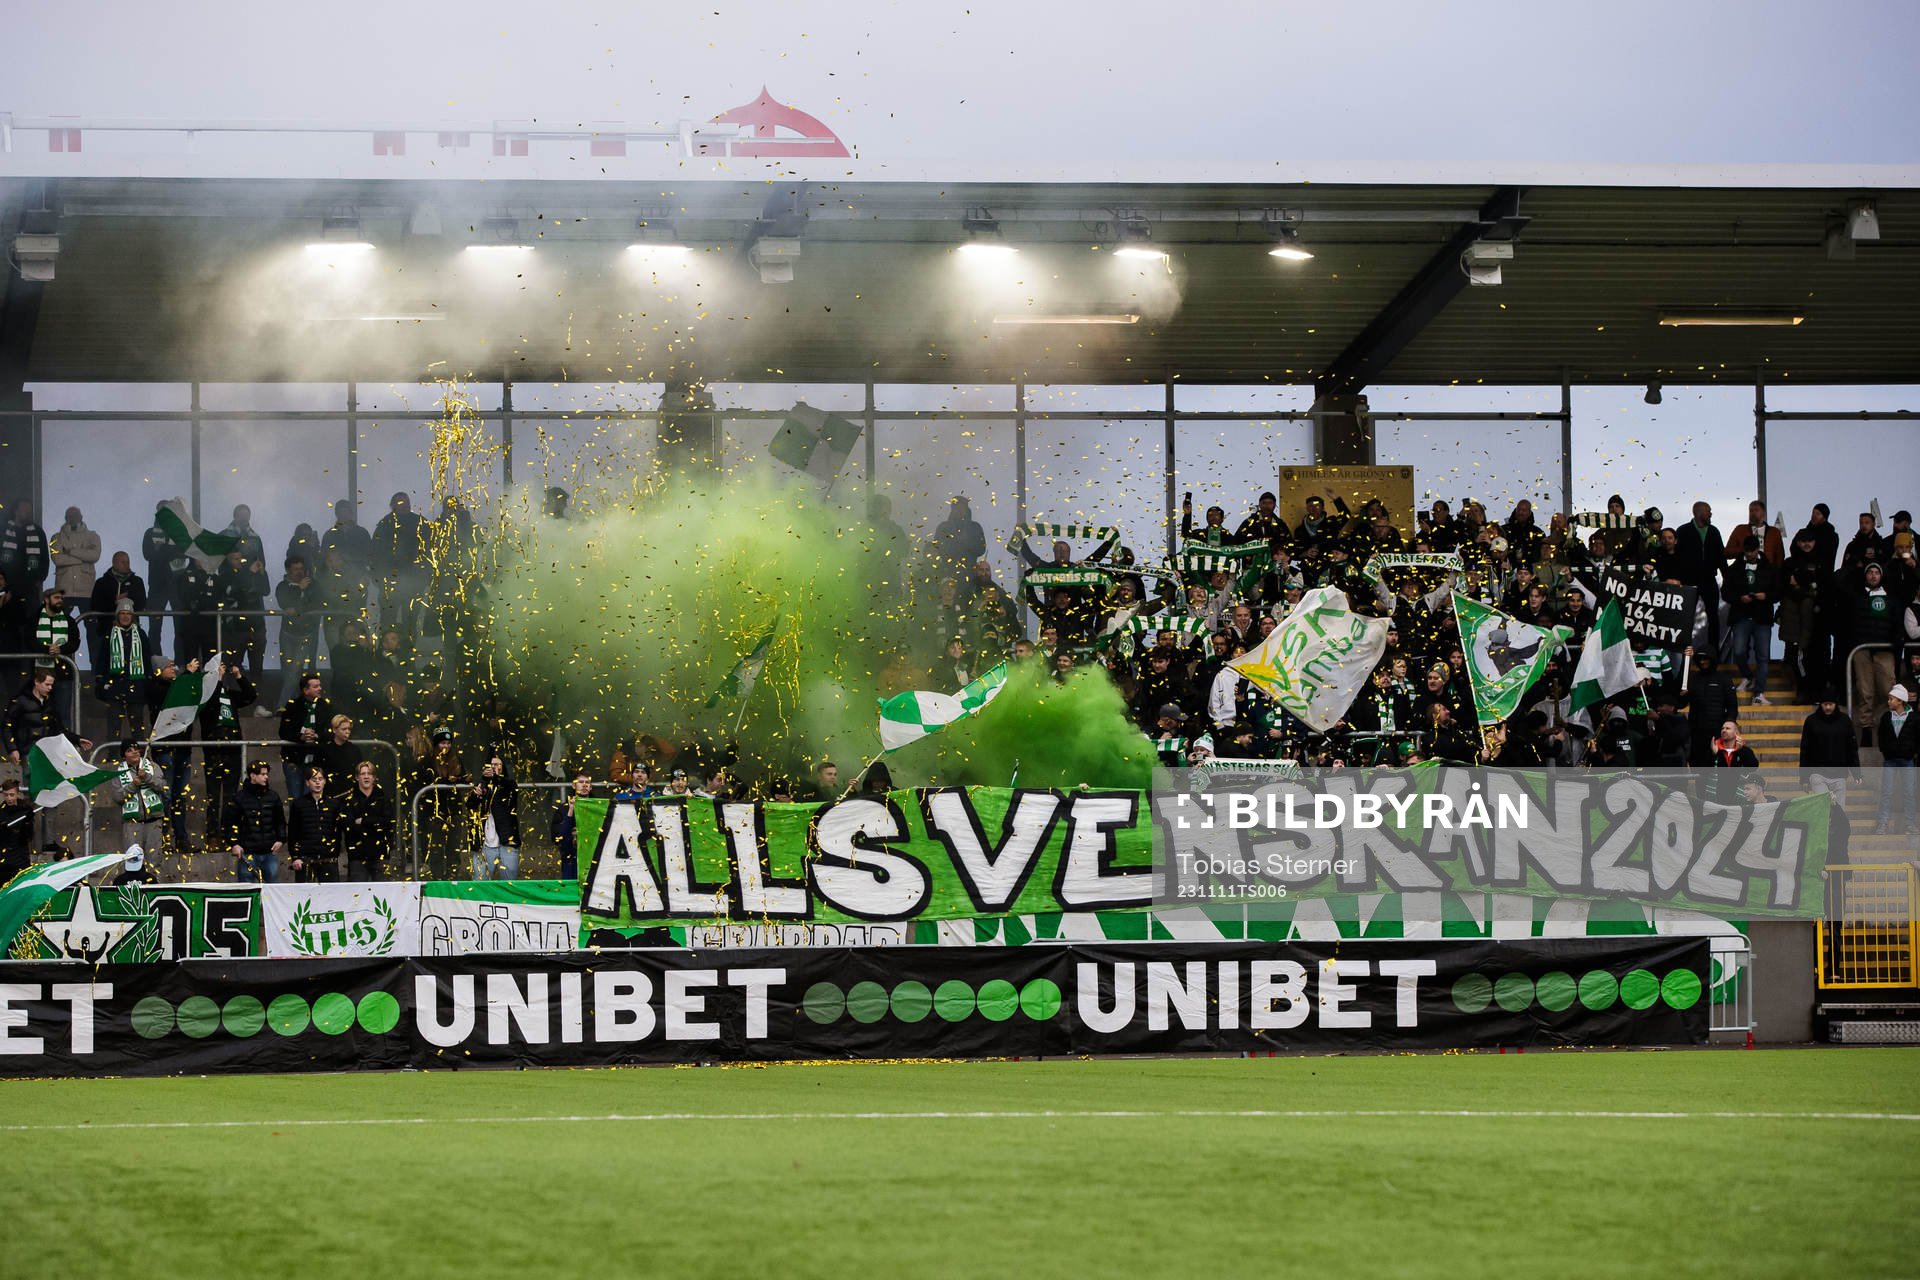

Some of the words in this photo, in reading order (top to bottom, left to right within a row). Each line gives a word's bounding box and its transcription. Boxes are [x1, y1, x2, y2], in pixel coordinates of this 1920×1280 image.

[1605, 576, 1627, 598] NO
[1630, 588, 1684, 611] JABIR
[1625, 602, 1655, 622] 164
[1624, 616, 1682, 643] PARTY
[1591, 775, 1809, 908] 2024
[309, 914, 337, 923] VSK
[421, 905, 573, 957] GRÖNA
[415, 969, 786, 1047] UNIBET
[1076, 959, 1437, 1034] UNIBET
